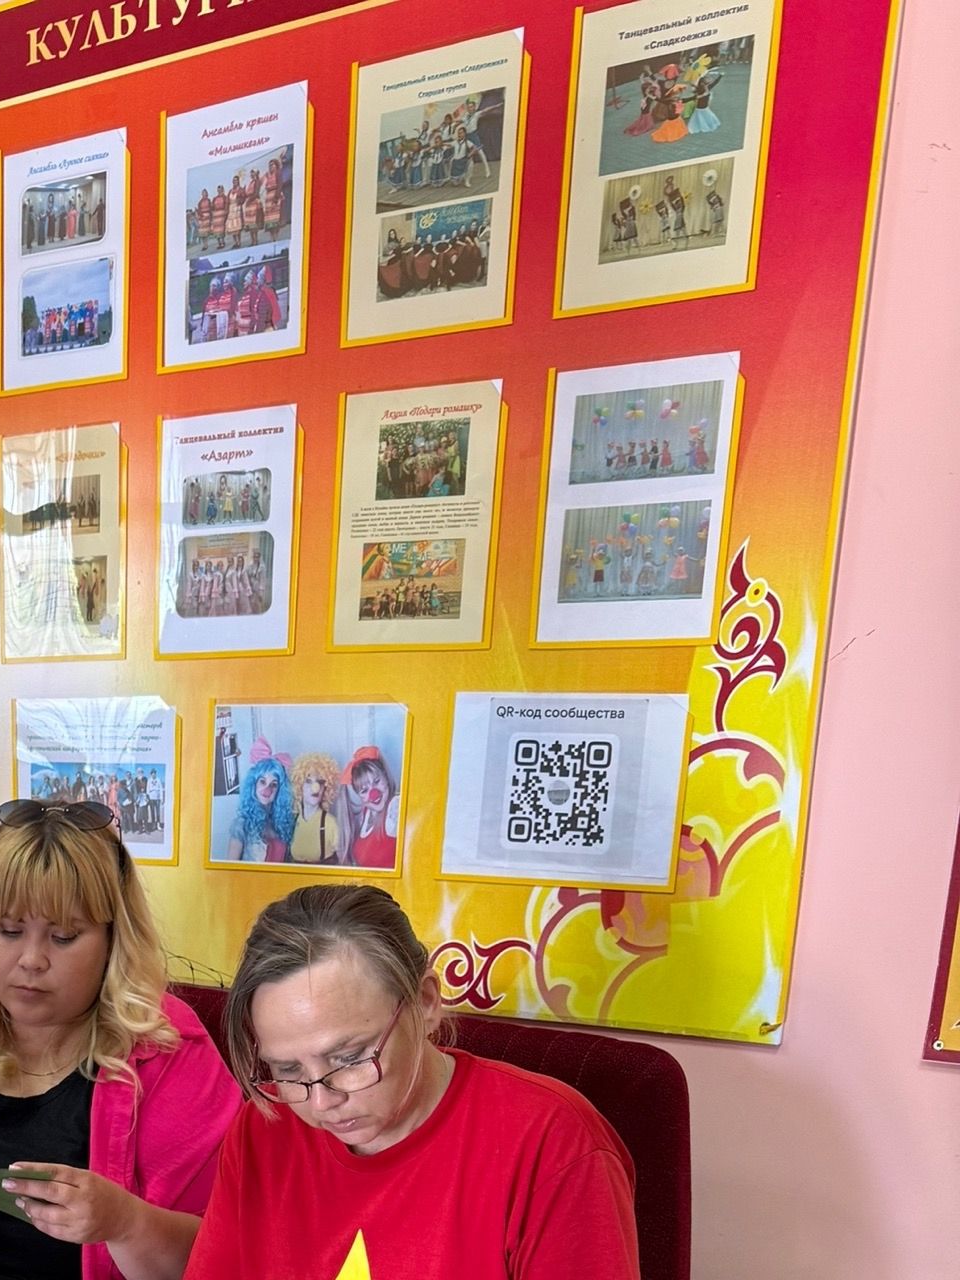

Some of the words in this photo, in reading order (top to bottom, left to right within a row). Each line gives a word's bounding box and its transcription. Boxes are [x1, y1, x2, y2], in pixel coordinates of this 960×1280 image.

[617, 16, 692, 40] Танцевальный
[694, 4, 749, 23] коллектив
[26, 0, 253, 66] КУЛЬТУ
[644, 28, 718, 50] «Сладкоежка»
[201, 120, 243, 139] Ансамбль
[381, 409, 407, 420] Акция
[238, 426, 284, 438] коллектив
[200, 449, 254, 464] «Азарт»
[496, 705, 541, 720] QR-код
[544, 707, 625, 720] сообщества
